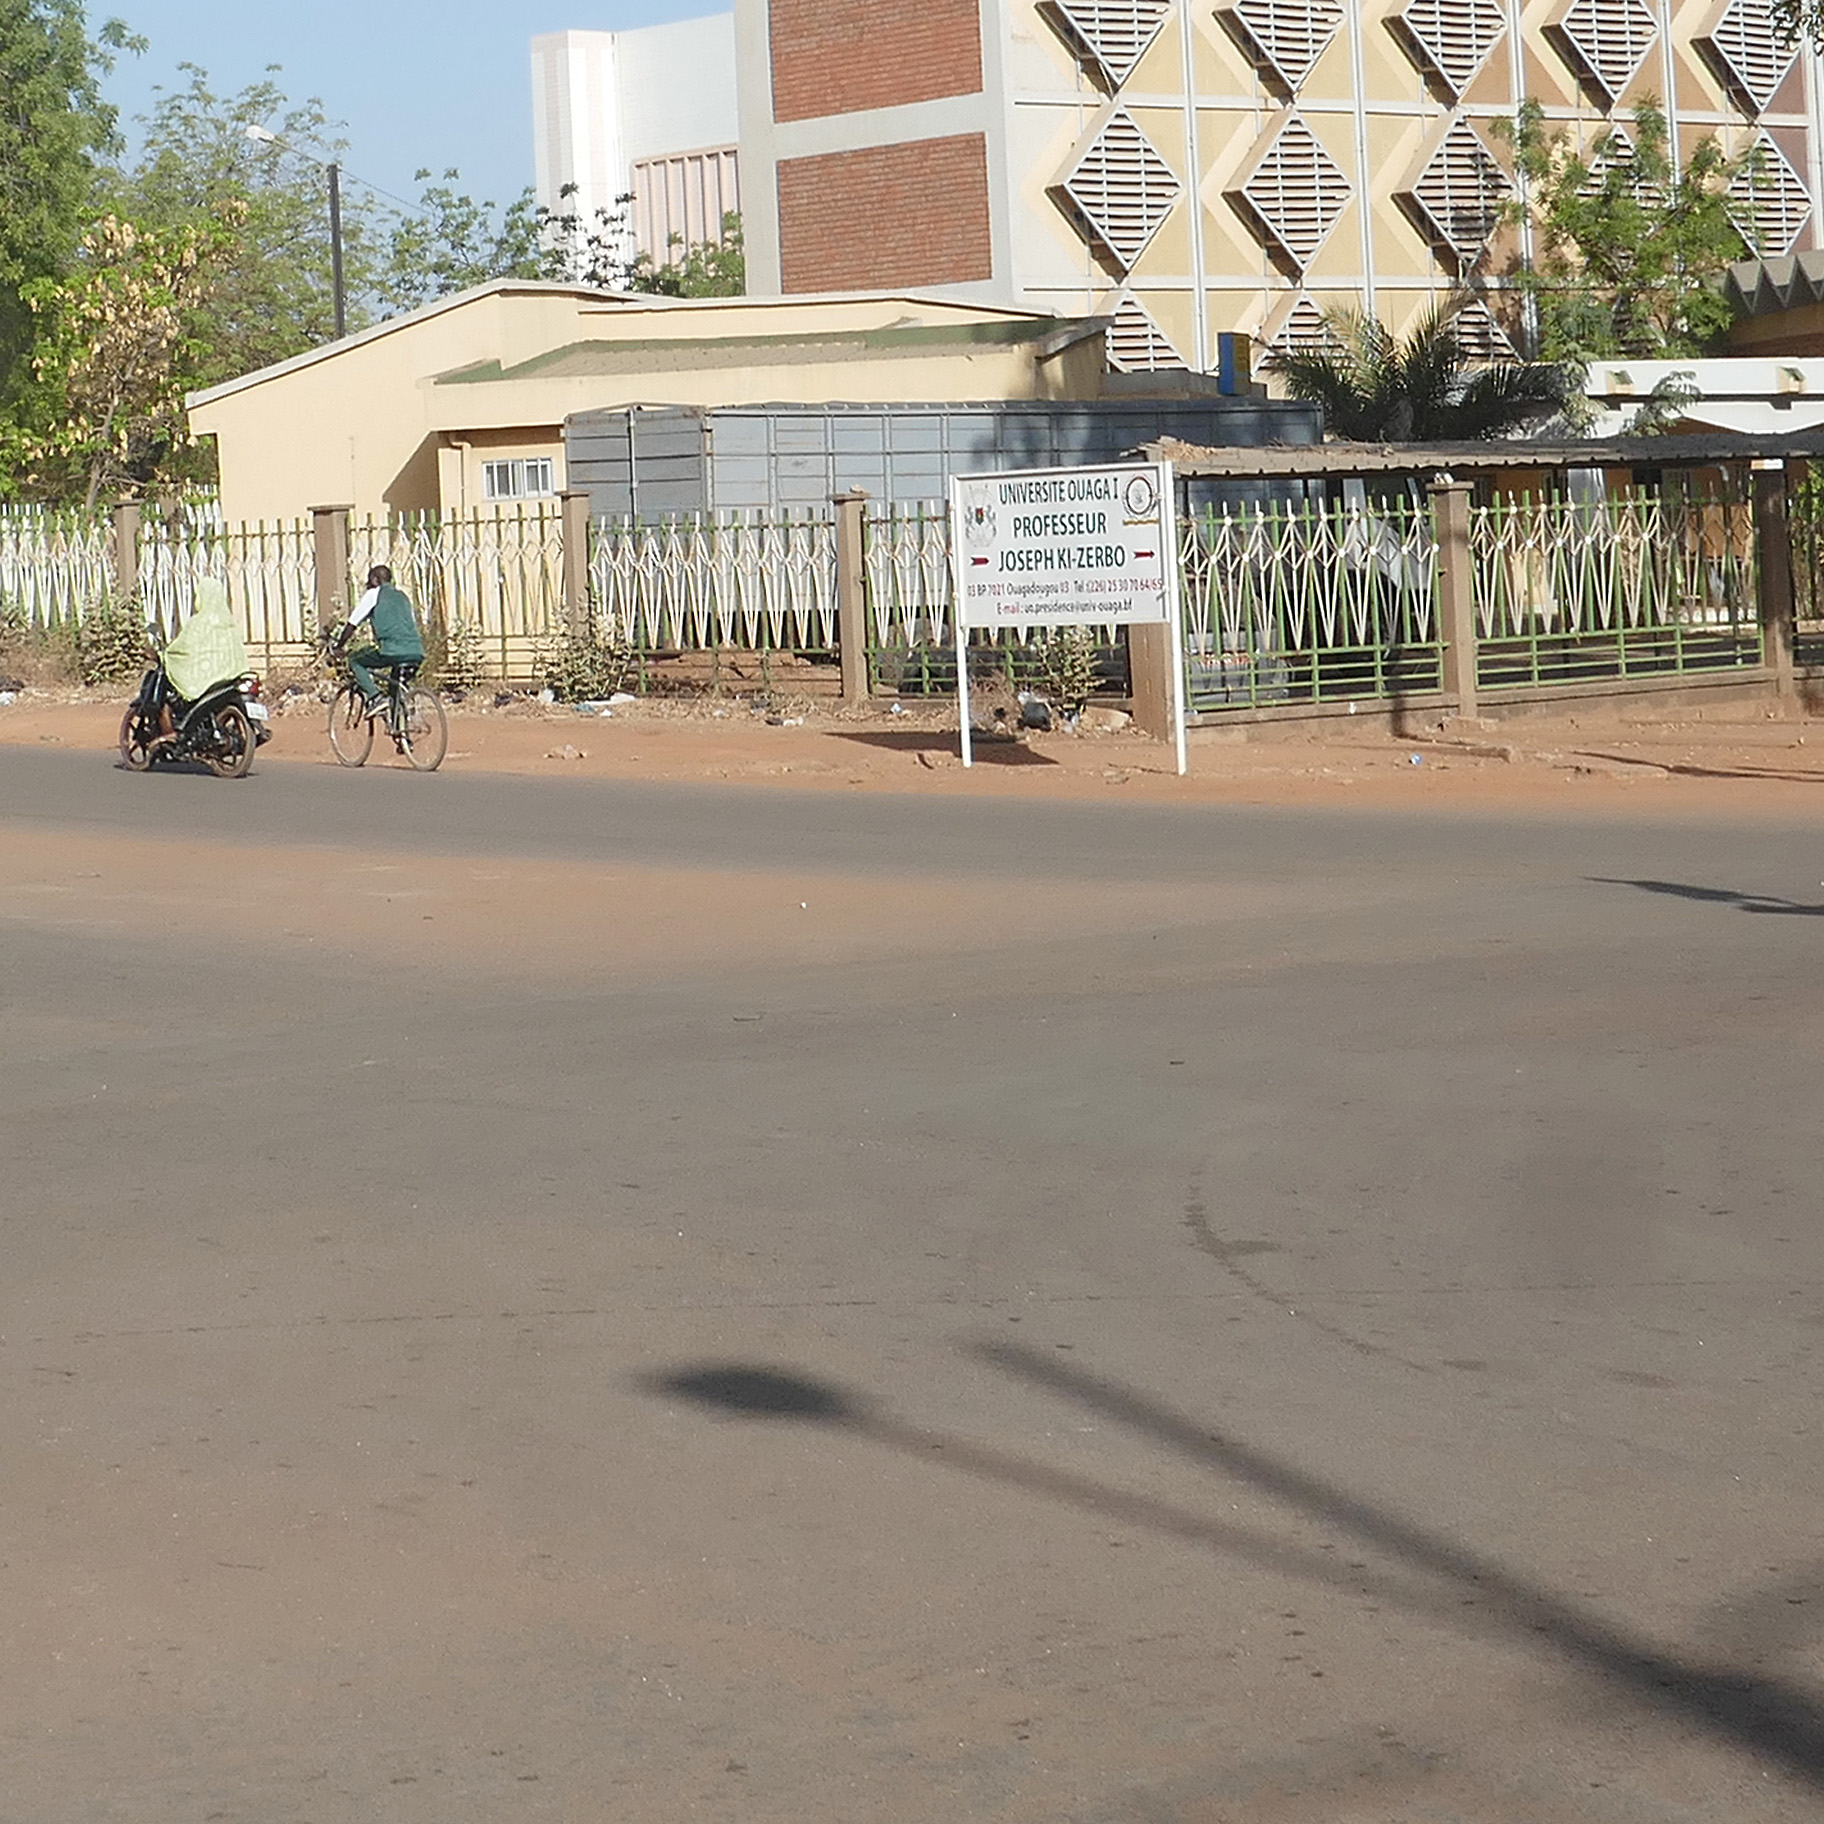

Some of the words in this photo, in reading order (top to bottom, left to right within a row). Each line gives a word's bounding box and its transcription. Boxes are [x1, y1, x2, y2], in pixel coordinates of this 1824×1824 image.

[998, 480, 1066, 505] UNIVERSITE
[1068, 478, 1111, 501] OUAGA
[1112, 477, 1119, 499] I
[1013, 511, 1107, 538] PROFESSEUR
[998, 548, 1055, 572] JOSEPH
[1057, 545, 1126, 570] KI-ZERBO
[977, 583, 987, 596] BP
[1007, 581, 1059, 598] Ouagadougou
